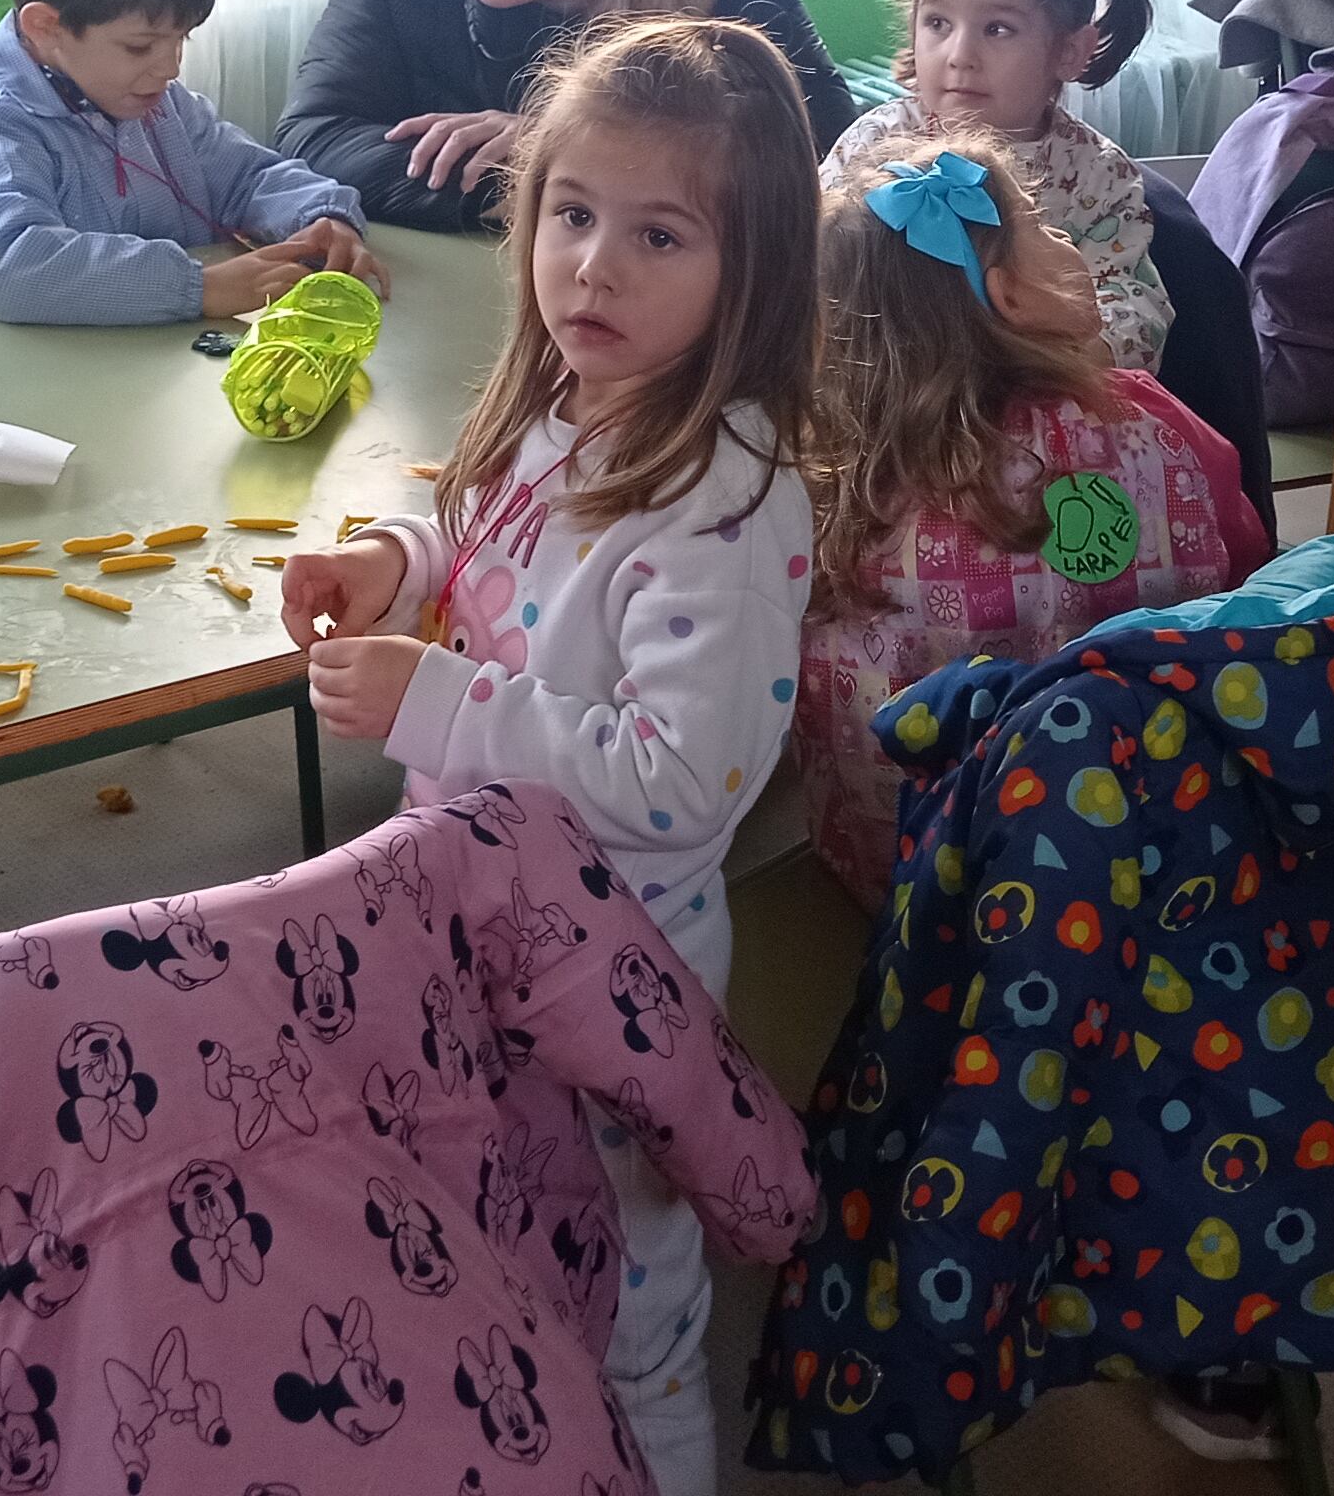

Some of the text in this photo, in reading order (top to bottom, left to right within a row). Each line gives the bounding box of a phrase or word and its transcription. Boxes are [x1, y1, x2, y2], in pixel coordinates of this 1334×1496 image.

[1064, 552, 1120, 576] LARA
[971, 585, 1006, 608] Peppa
[983, 606, 1005, 620] Pig
